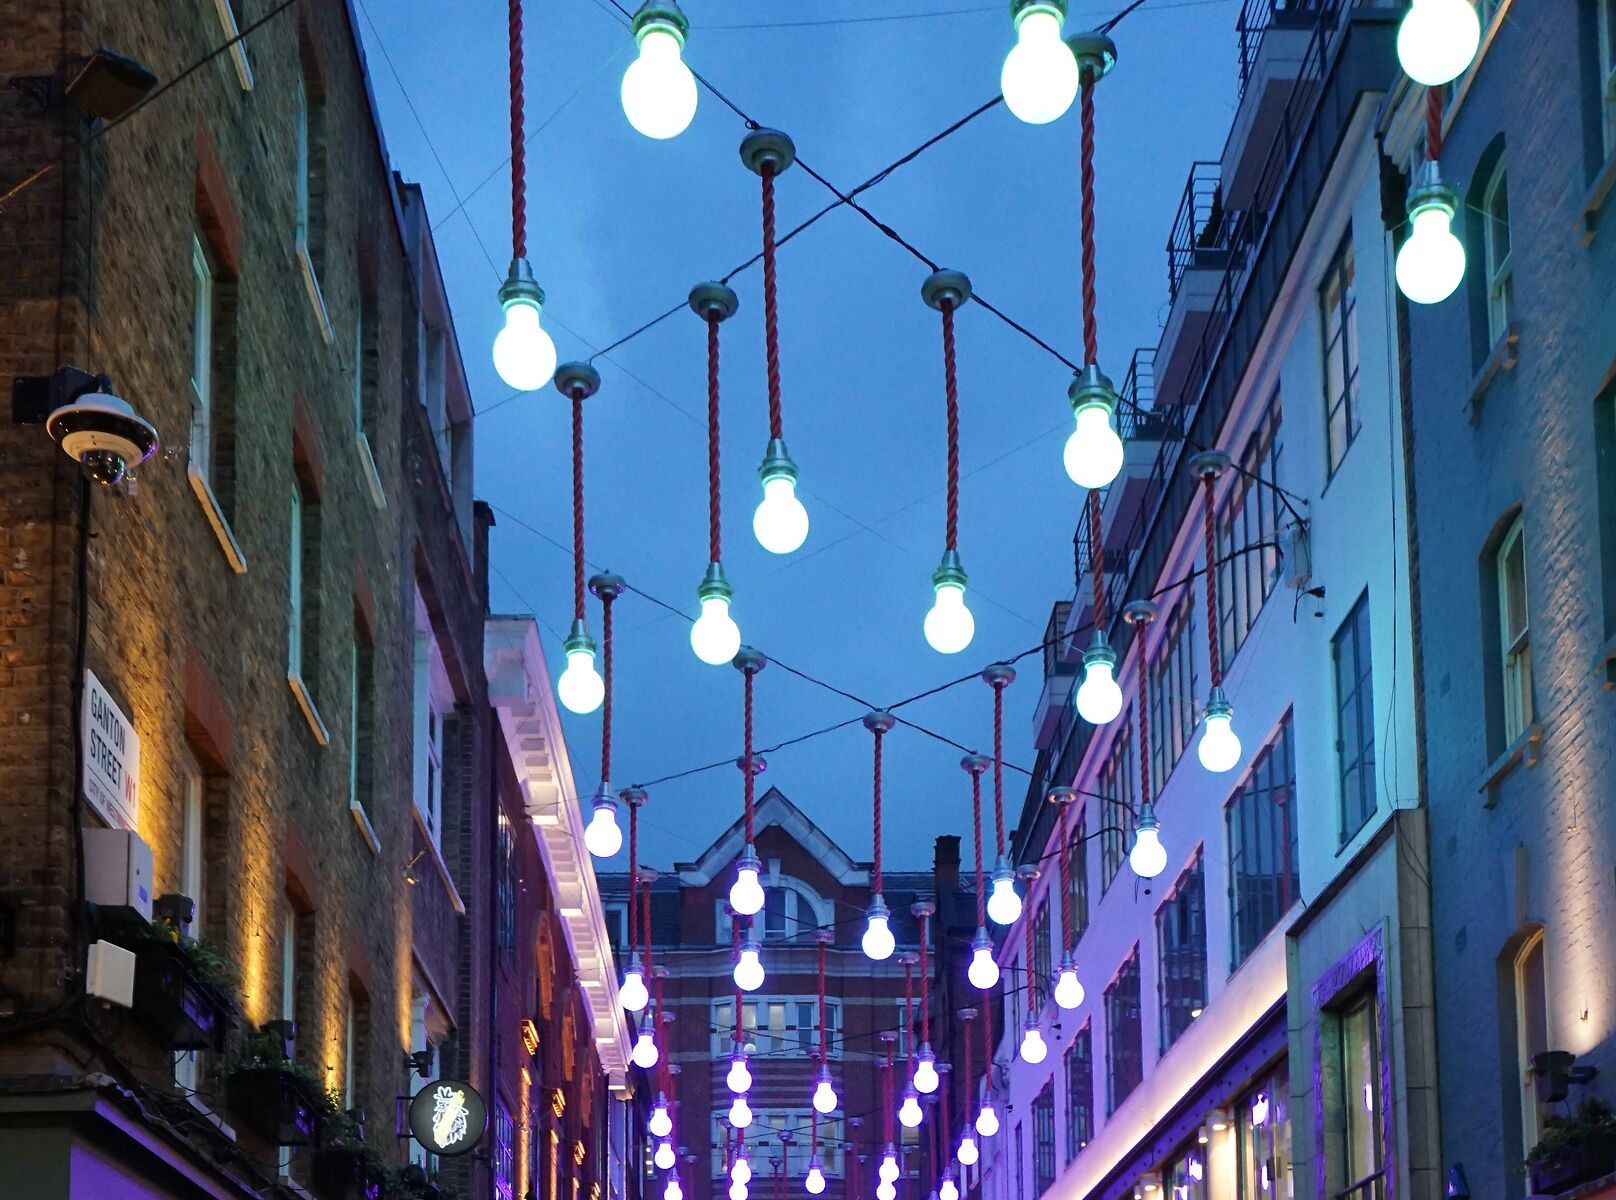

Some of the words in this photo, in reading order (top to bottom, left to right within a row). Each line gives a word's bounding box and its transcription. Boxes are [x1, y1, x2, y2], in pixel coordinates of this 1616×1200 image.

[91, 688, 126, 756] GANTON
[89, 778, 99, 797] CITY
[100, 791, 106, 805] OF
[90, 729, 122, 790] STREET
[124, 770, 136, 808] W1
